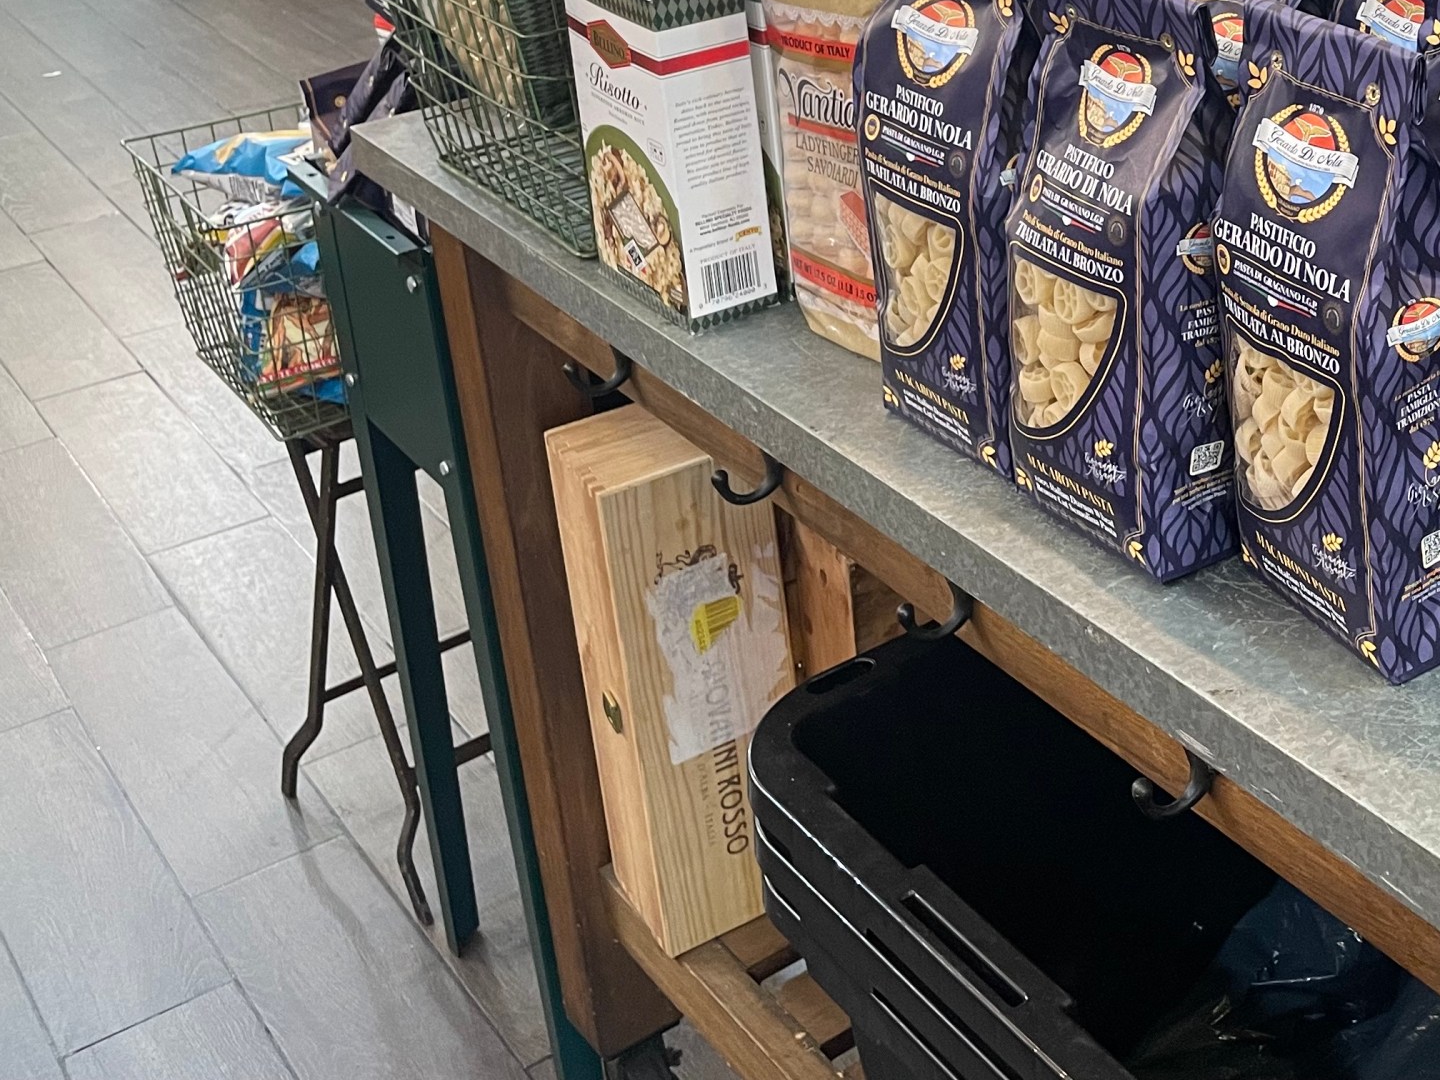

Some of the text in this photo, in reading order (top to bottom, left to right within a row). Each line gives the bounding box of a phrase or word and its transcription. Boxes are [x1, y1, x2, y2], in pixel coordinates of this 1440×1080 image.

[814, 42, 825, 54] OF
[827, 44, 851, 58] ITALY
[588, 62, 642, 111] Risotto
[896, 84, 944, 117] PASTIFICIO
[866, 91, 972, 151] GERARDO DI NOLA
[795, 132, 859, 166] LADYFINGER
[807, 156, 858, 187] SAVOIARDI
[1064, 143, 1115, 180] PASTIFICIO
[1036, 149, 1133, 216] GERARDO DI NOLA
[1250, 213, 1317, 259] PASTIFICIO
[1214, 218, 1351, 303] GERARDO DI NOLA
[1027, 453, 1081, 498] MACARONI
[1082, 485, 1115, 516] PASTA
[718, 773, 749, 855] ROSSO
